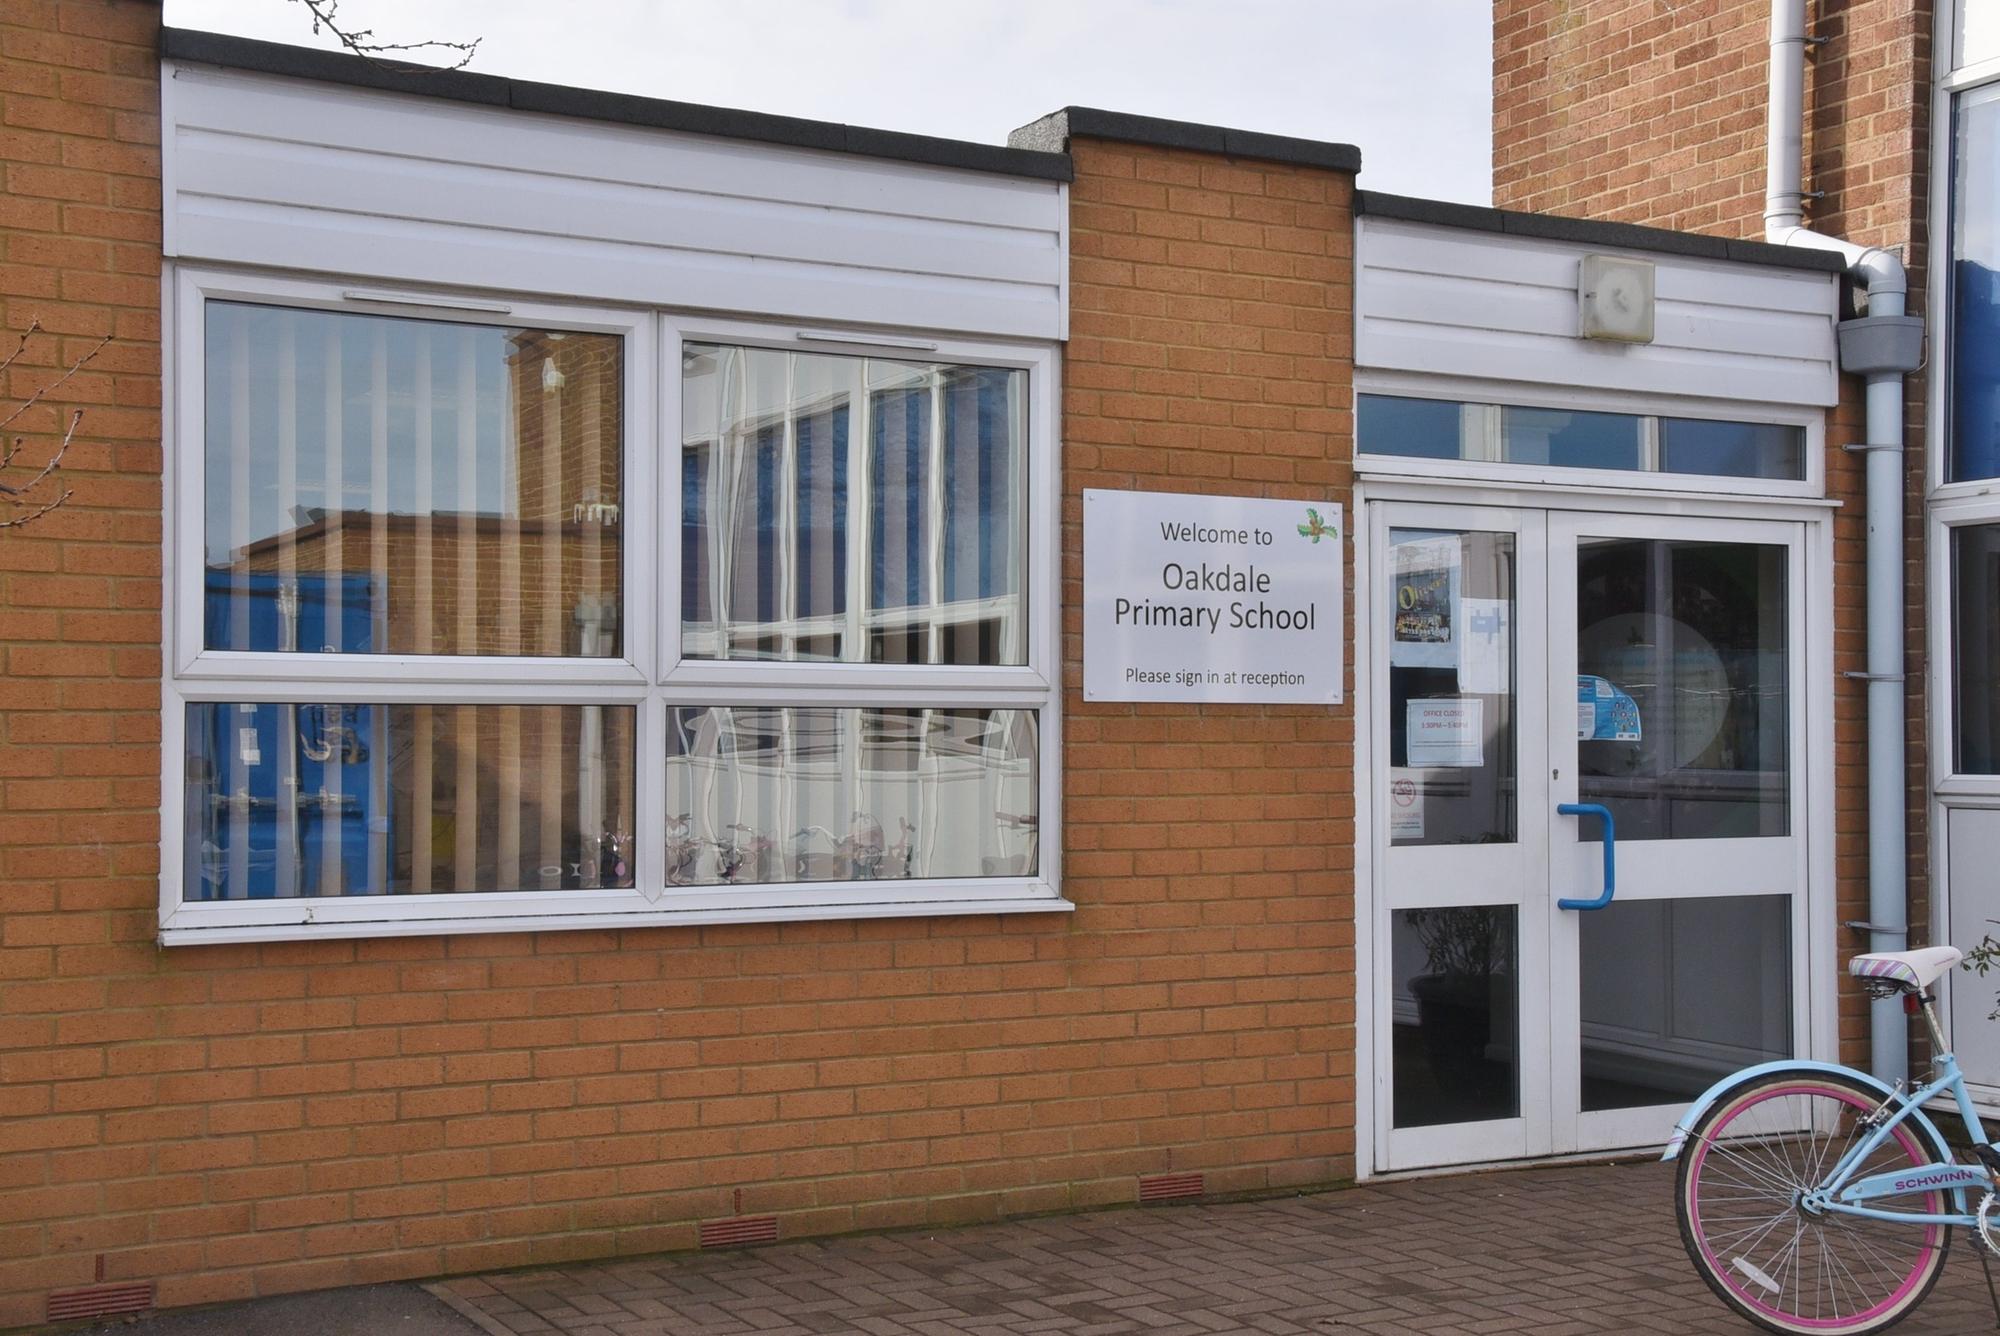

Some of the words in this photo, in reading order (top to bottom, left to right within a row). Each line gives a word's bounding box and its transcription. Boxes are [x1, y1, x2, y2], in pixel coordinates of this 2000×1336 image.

[1160, 521, 1248, 544] Welcome
[1254, 528, 1273, 546] to
[1163, 563, 1271, 593] Oakdale
[1115, 598, 1221, 634] Primary
[1230, 601, 1315, 630] School
[1125, 667, 1171, 683] Please
[1175, 669, 1202, 687] sign
[1207, 669, 1219, 684] in
[1223, 671, 1237, 684] at
[1241, 671, 1305, 688] reception
[1894, 1169, 1973, 1190] SCHWINN
